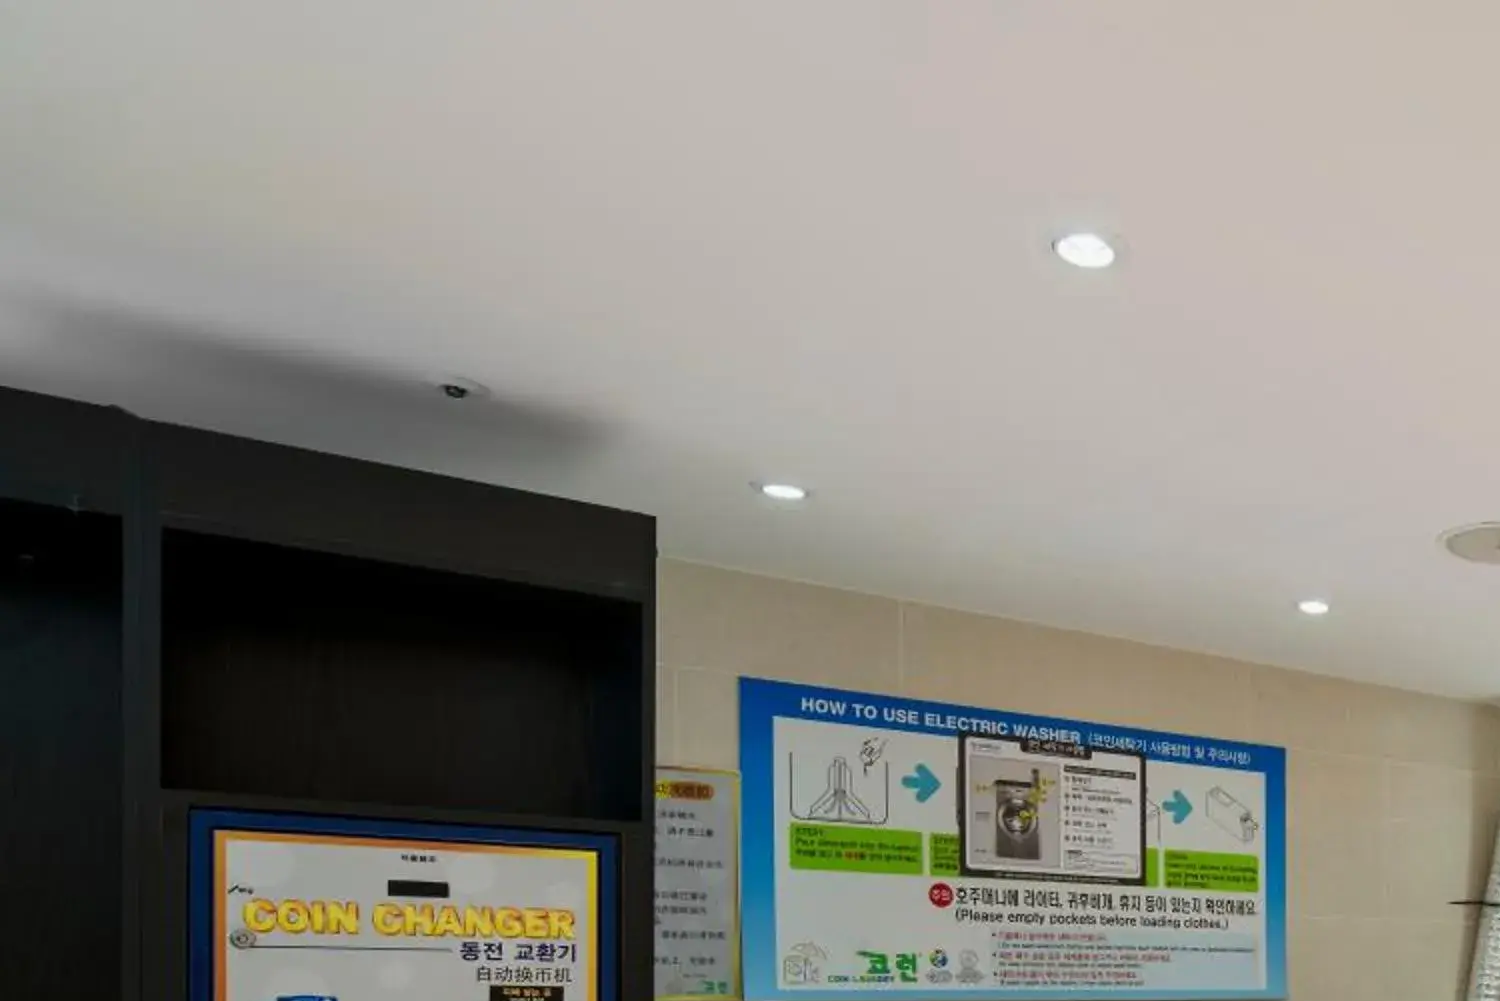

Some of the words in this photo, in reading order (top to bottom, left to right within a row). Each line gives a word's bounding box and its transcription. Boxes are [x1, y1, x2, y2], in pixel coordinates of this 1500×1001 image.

[801, 697, 846, 716] HOW
[852, 703, 878, 720] TO
[883, 708, 919, 725] USE
[925, 713, 1009, 735] ELECTRIC
[1013, 723, 1082, 743] WASHER
[242, 898, 360, 936] COIN
[372, 903, 577, 941] CHANGER
[955, 909, 1004, 923] (Please
[1008, 912, 1045, 925] empty
[1050, 914, 1097, 925] pockets
[1100, 914, 1137, 927] before
[1140, 915, 1181, 929] loading
[460, 942, 503, 961] 동전
[514, 944, 577, 962] 교환기
